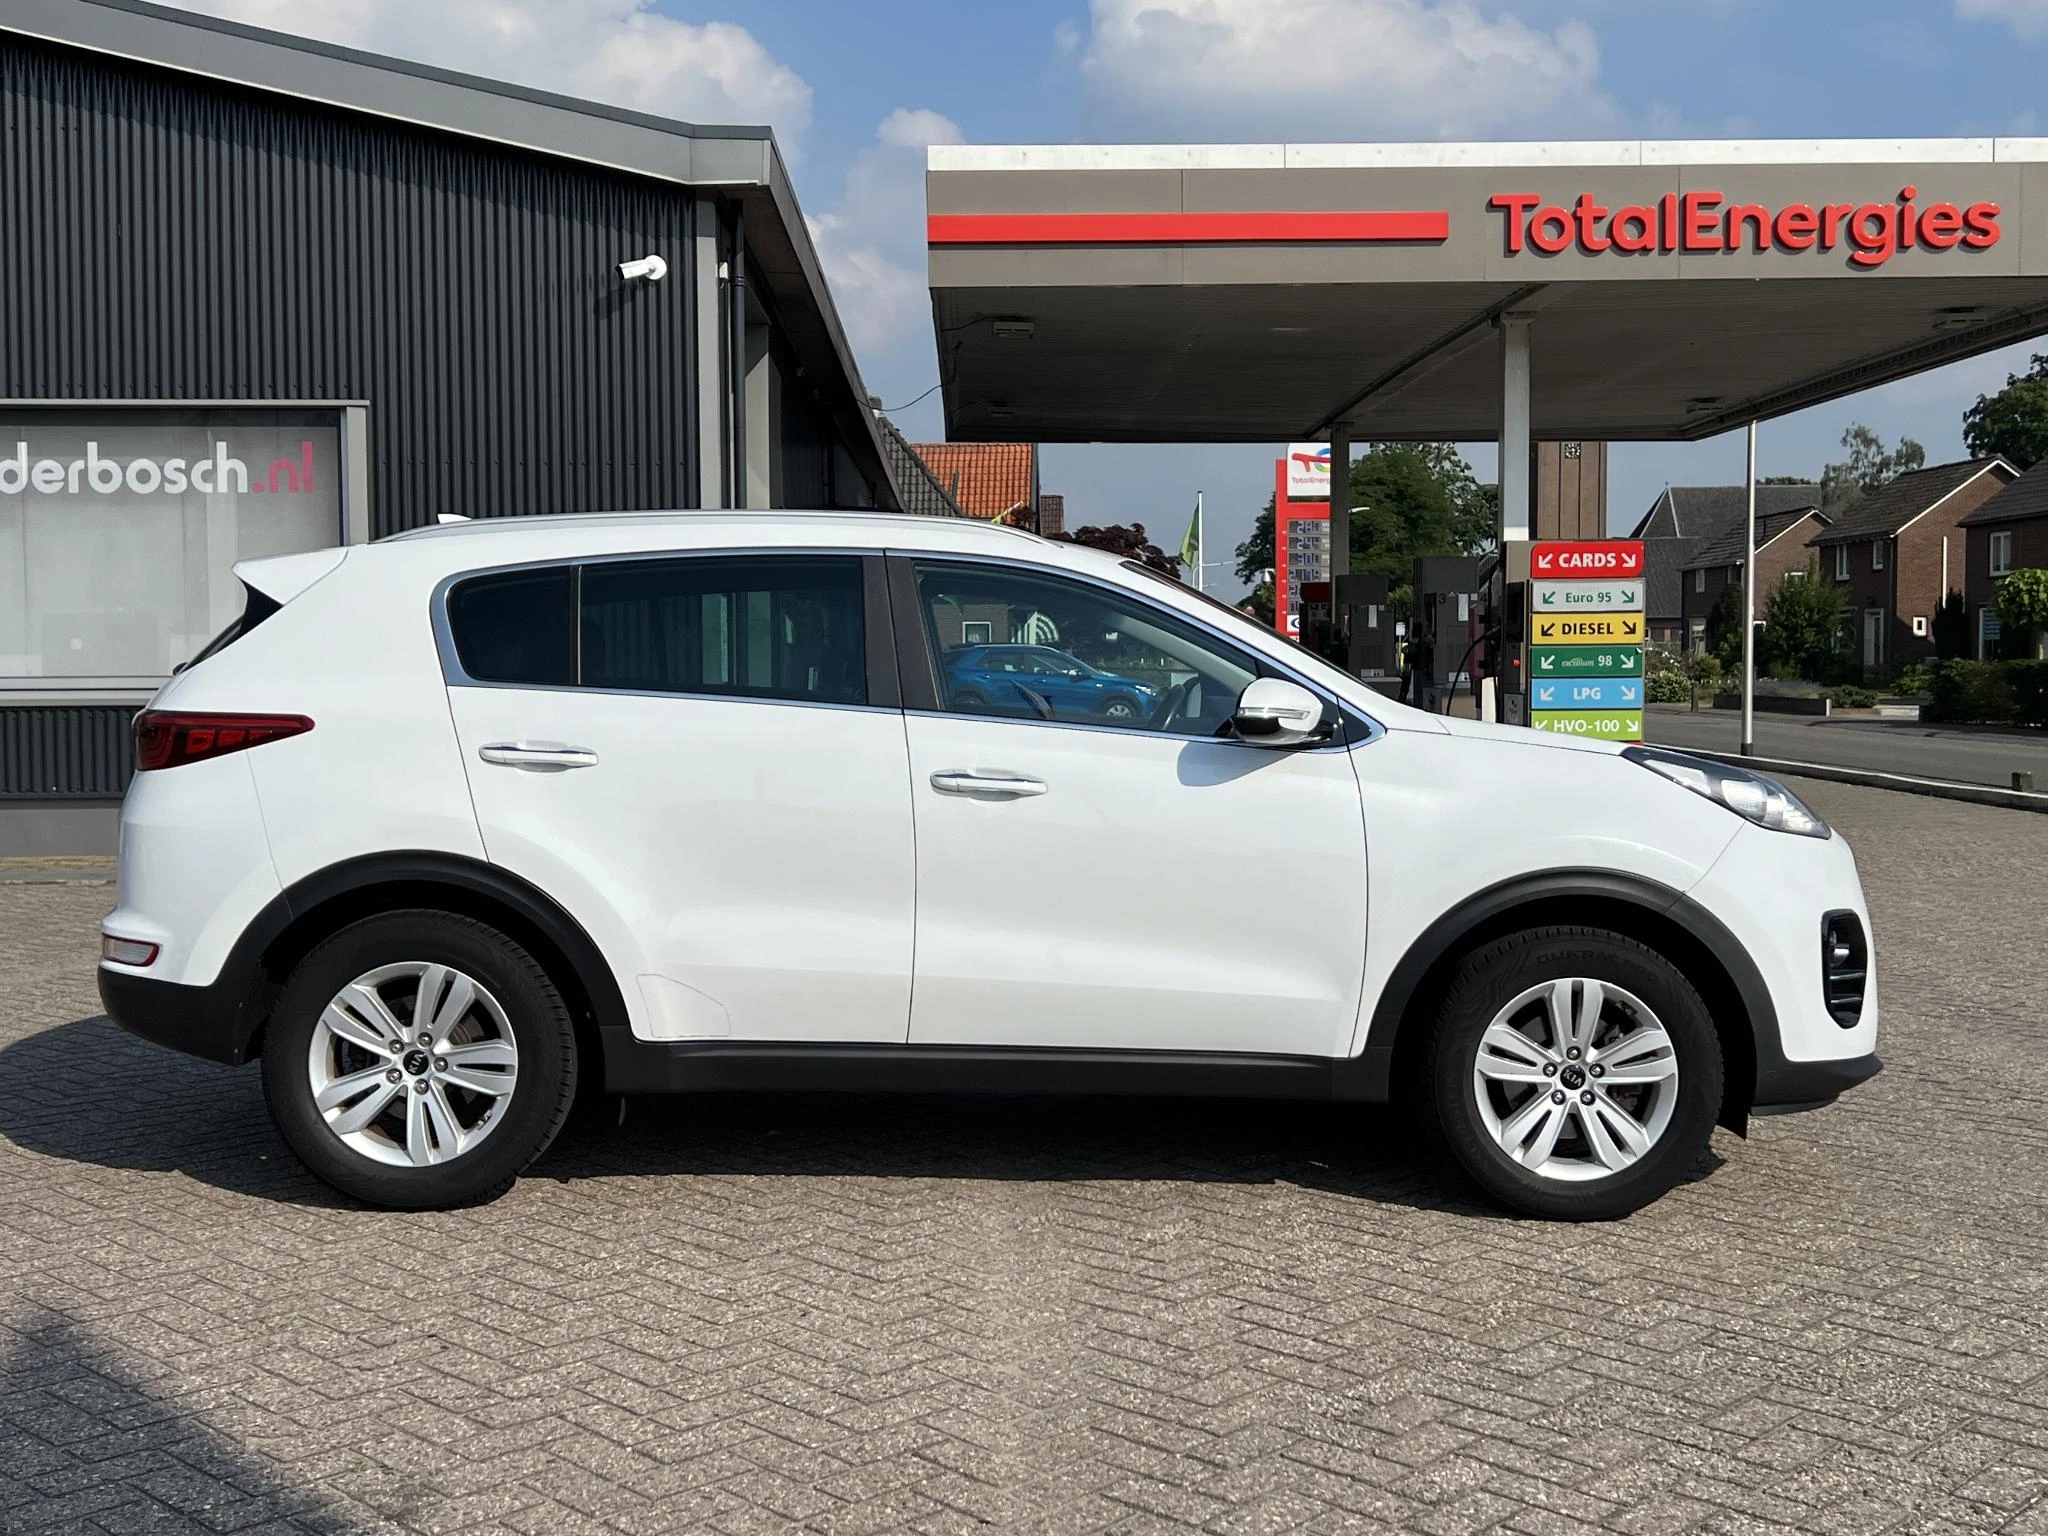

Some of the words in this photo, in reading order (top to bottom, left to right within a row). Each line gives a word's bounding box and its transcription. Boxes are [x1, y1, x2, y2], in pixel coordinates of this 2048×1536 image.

[1490, 186, 2001, 264] TotalEnergies
[1558, 552, 1617, 568] CARDS
[1565, 592, 1593, 603] Euro
[1597, 591, 1612, 603] 95
[1562, 622, 1614, 635] DIESEL
[1597, 655, 1613, 667] 98
[1573, 687, 1602, 700] LPG
[1553, 719, 1620, 732] HVO-100
[1563, 1068, 1583, 1087] KIA
